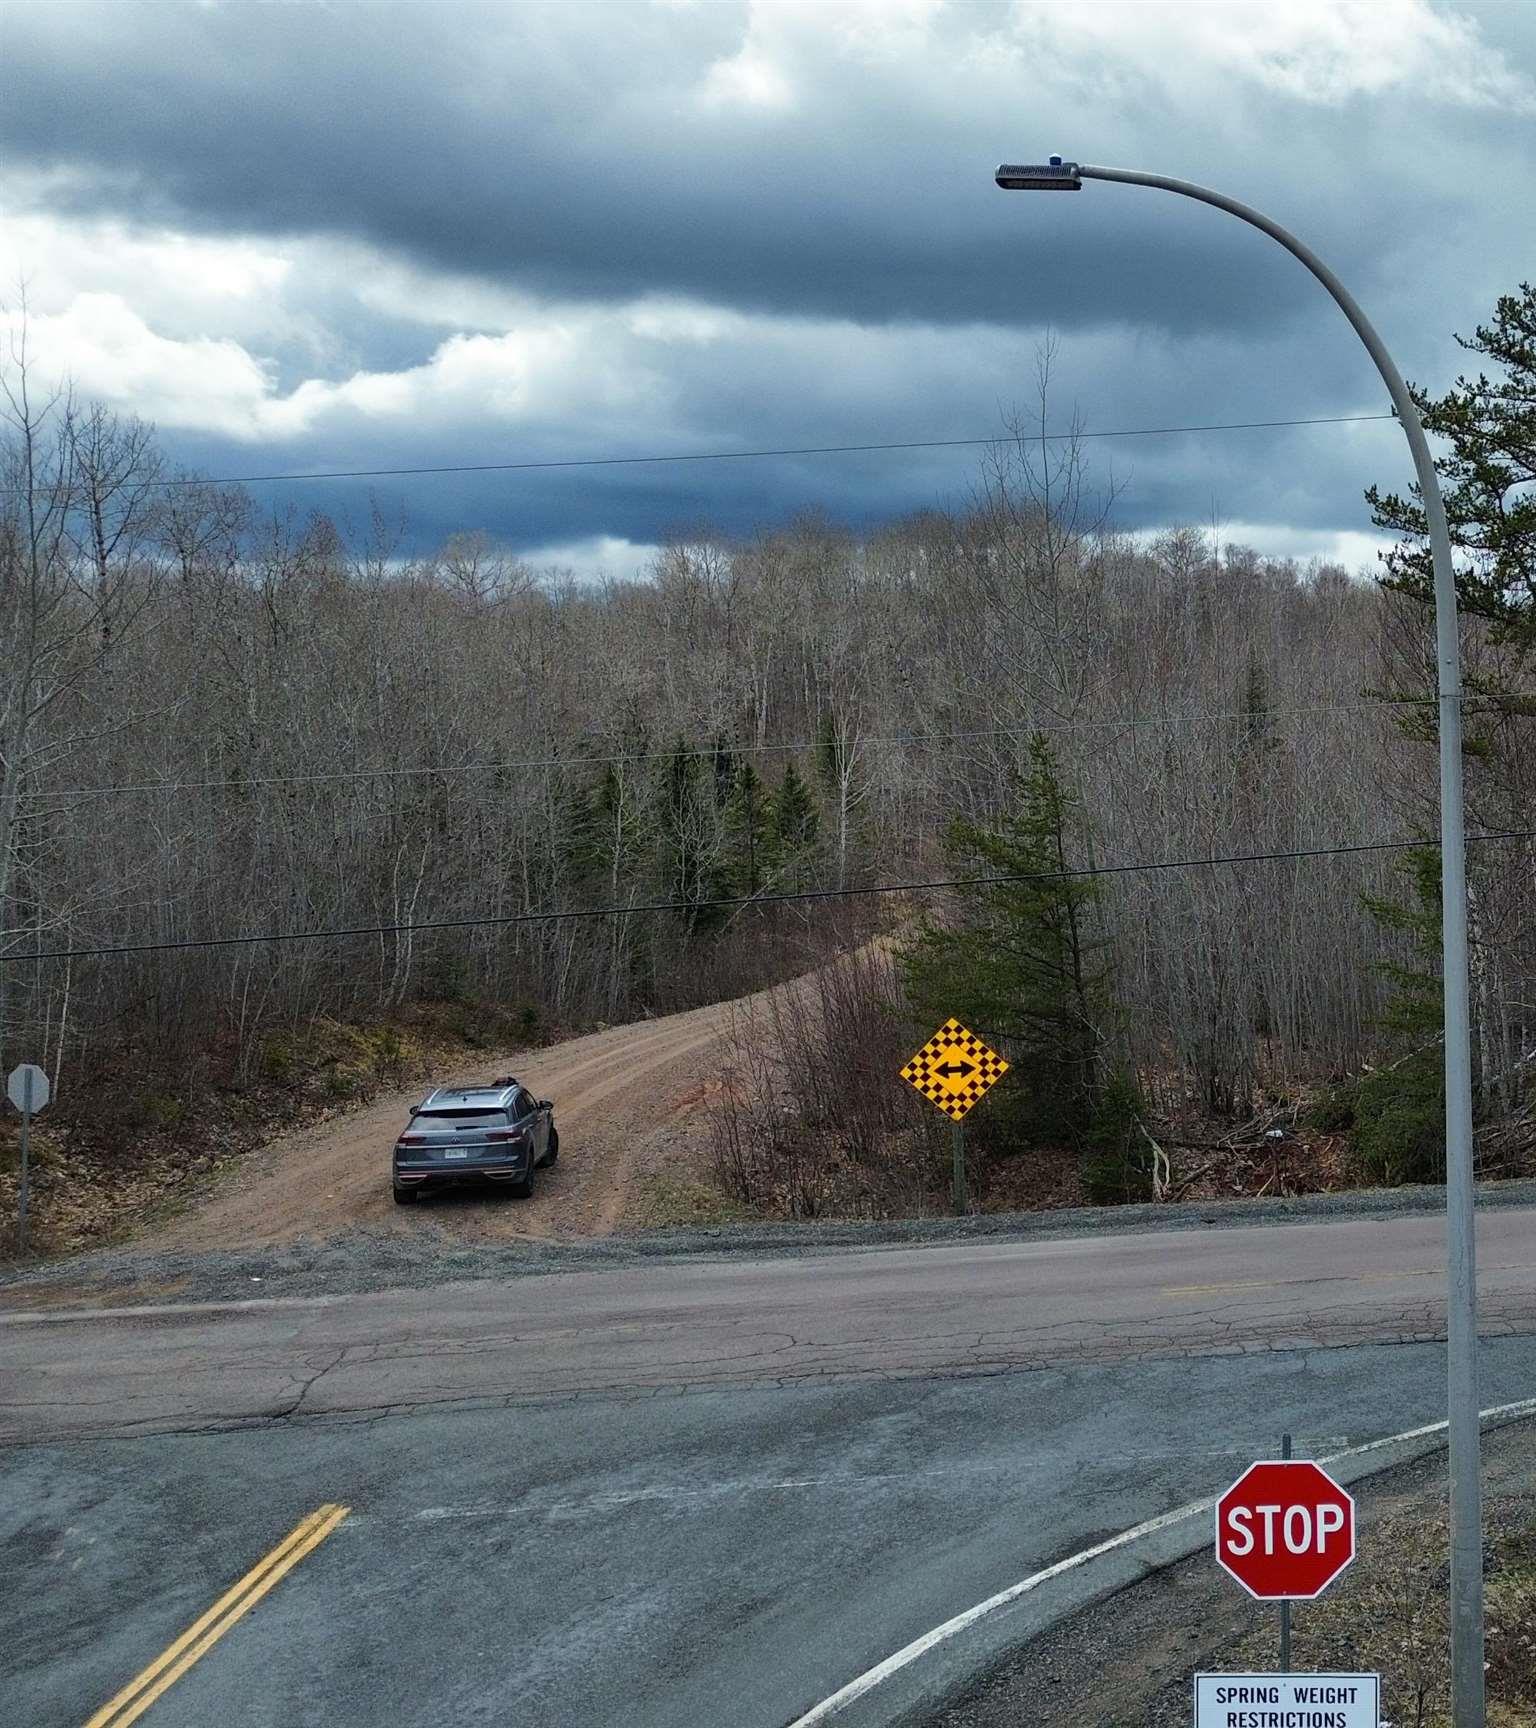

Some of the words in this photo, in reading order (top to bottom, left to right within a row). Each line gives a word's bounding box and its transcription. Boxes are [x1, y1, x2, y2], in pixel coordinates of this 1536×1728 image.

[1226, 1503, 1345, 1556] STOP
[1215, 1687, 1280, 1704] SPRING
[1293, 1686, 1359, 1704] WEIGHT
[1226, 1711, 1347, 1728] RESTRICTIONS
